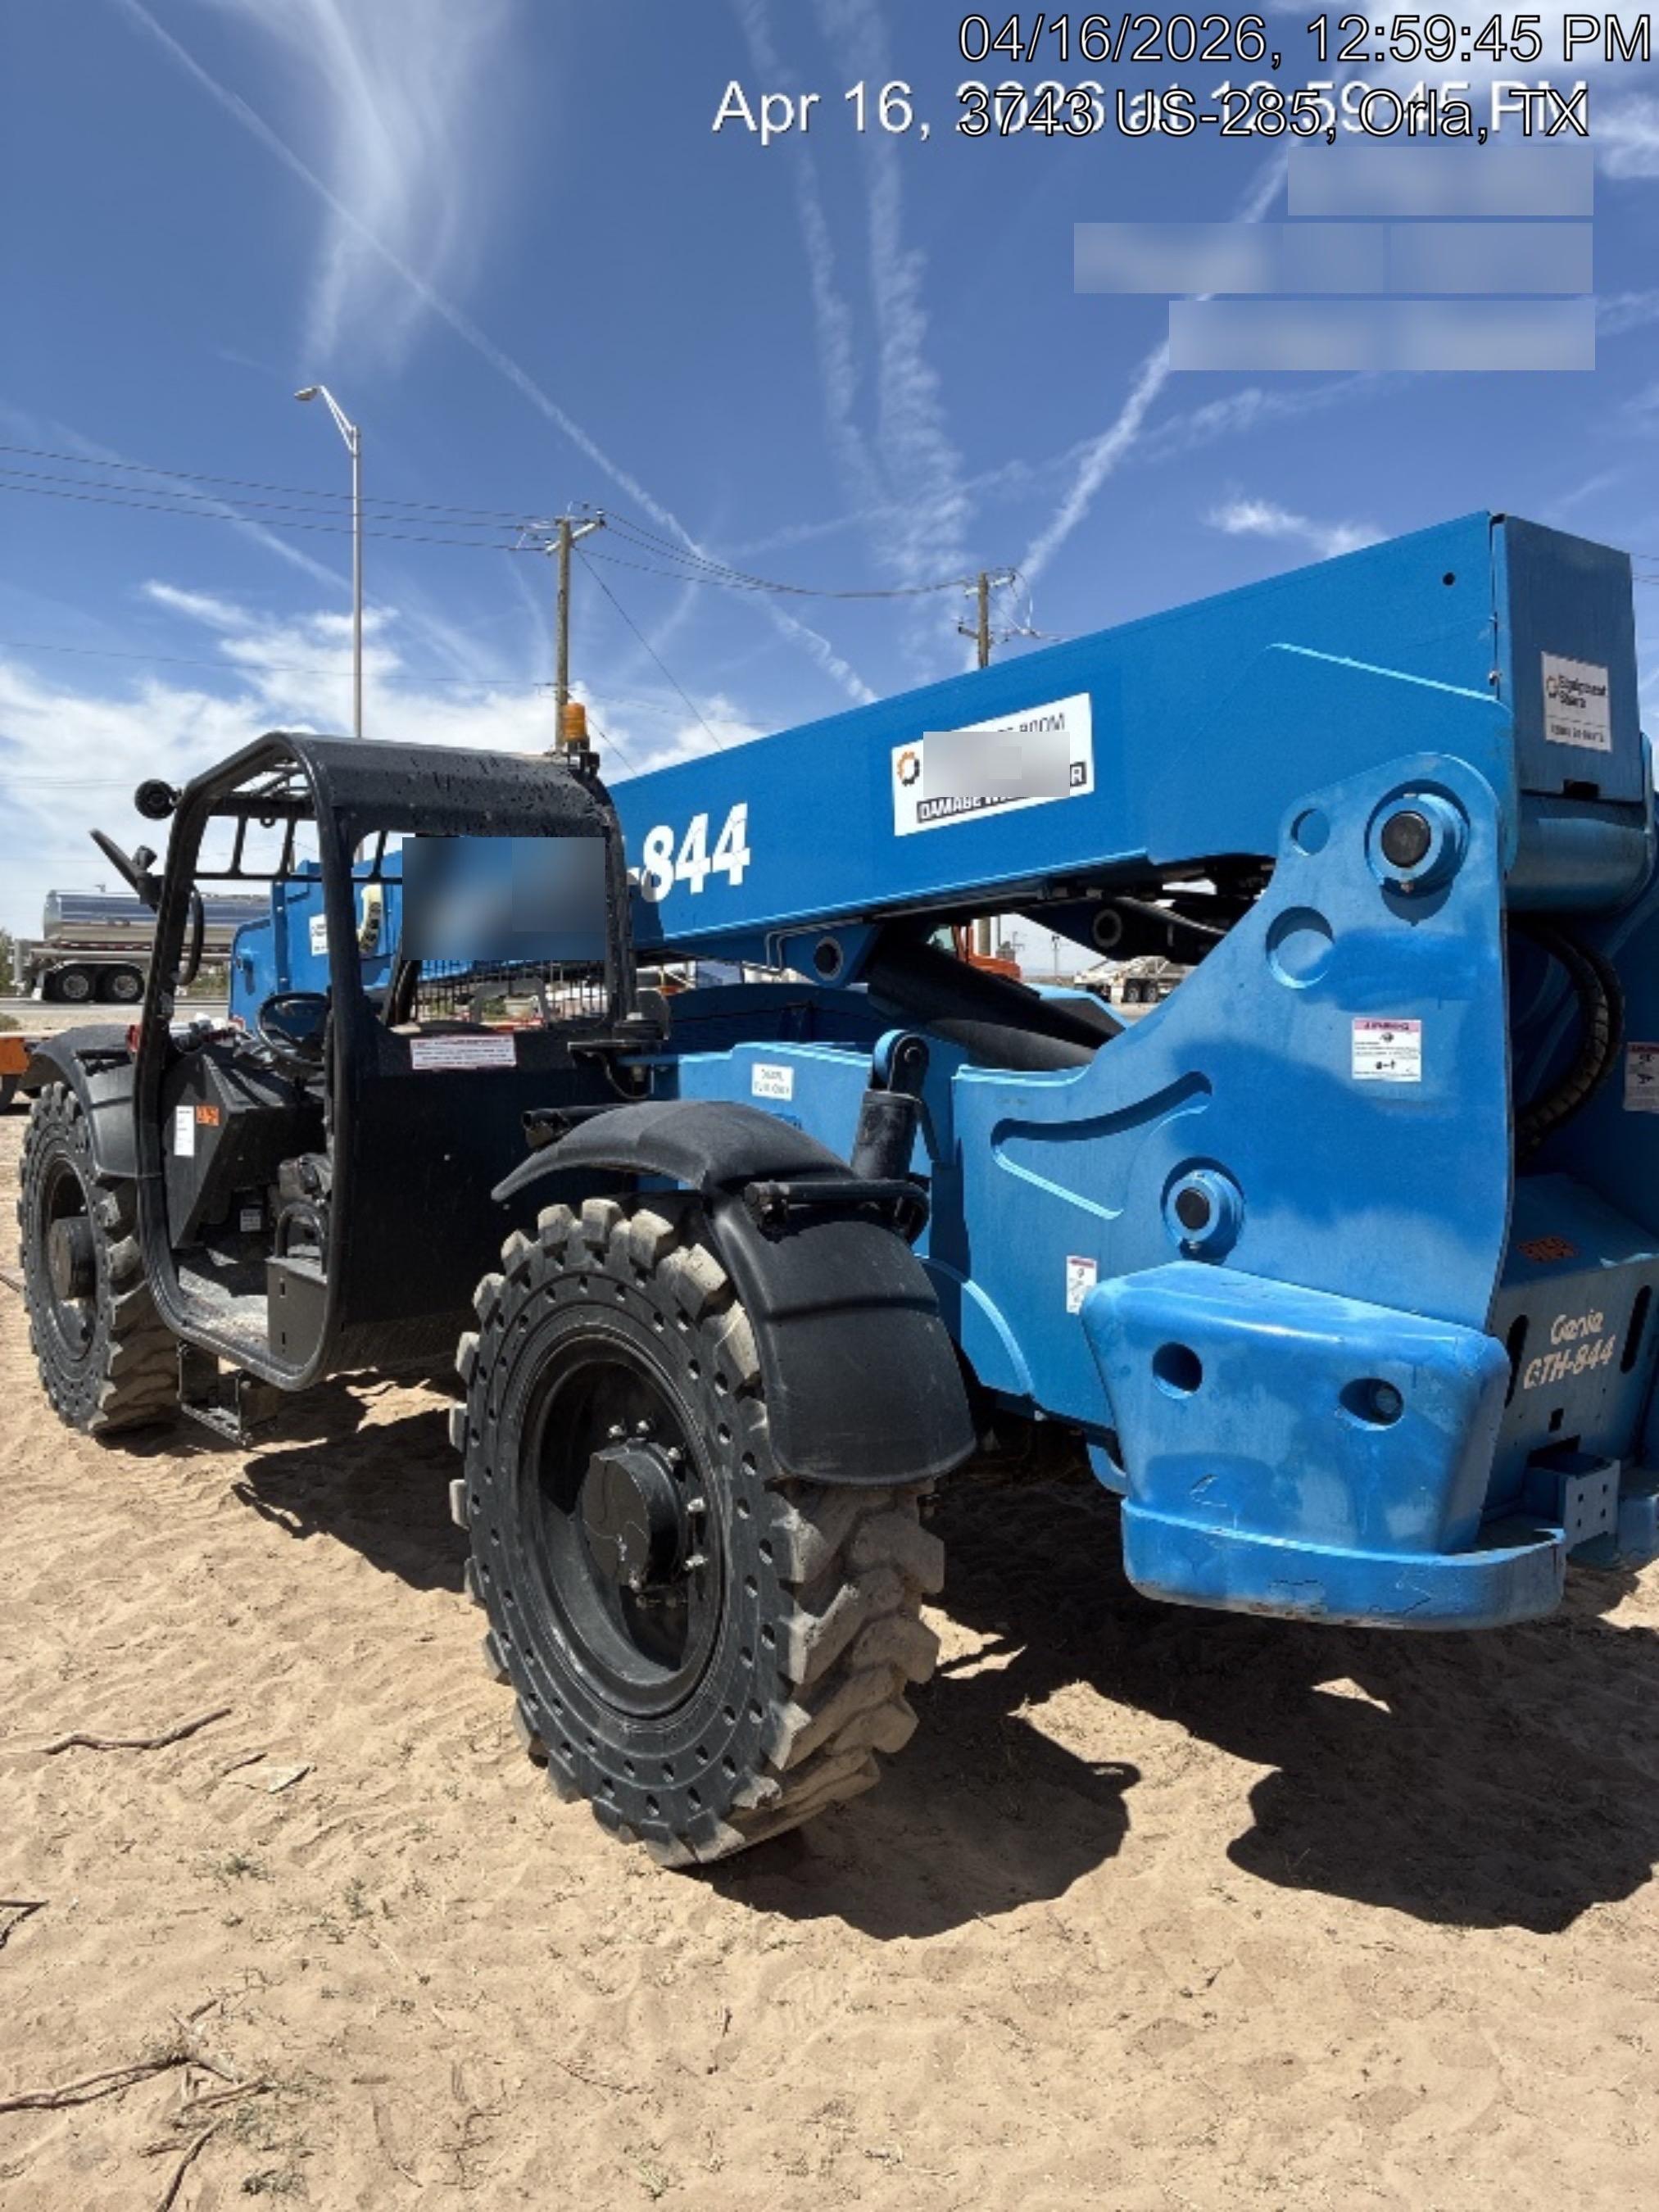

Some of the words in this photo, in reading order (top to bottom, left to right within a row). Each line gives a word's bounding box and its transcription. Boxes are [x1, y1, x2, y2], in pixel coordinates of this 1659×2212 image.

[625, 802, 750, 903] -844
[1550, 1308, 1604, 1345] Genie
[1523, 1333, 1616, 1390] GTH-844
